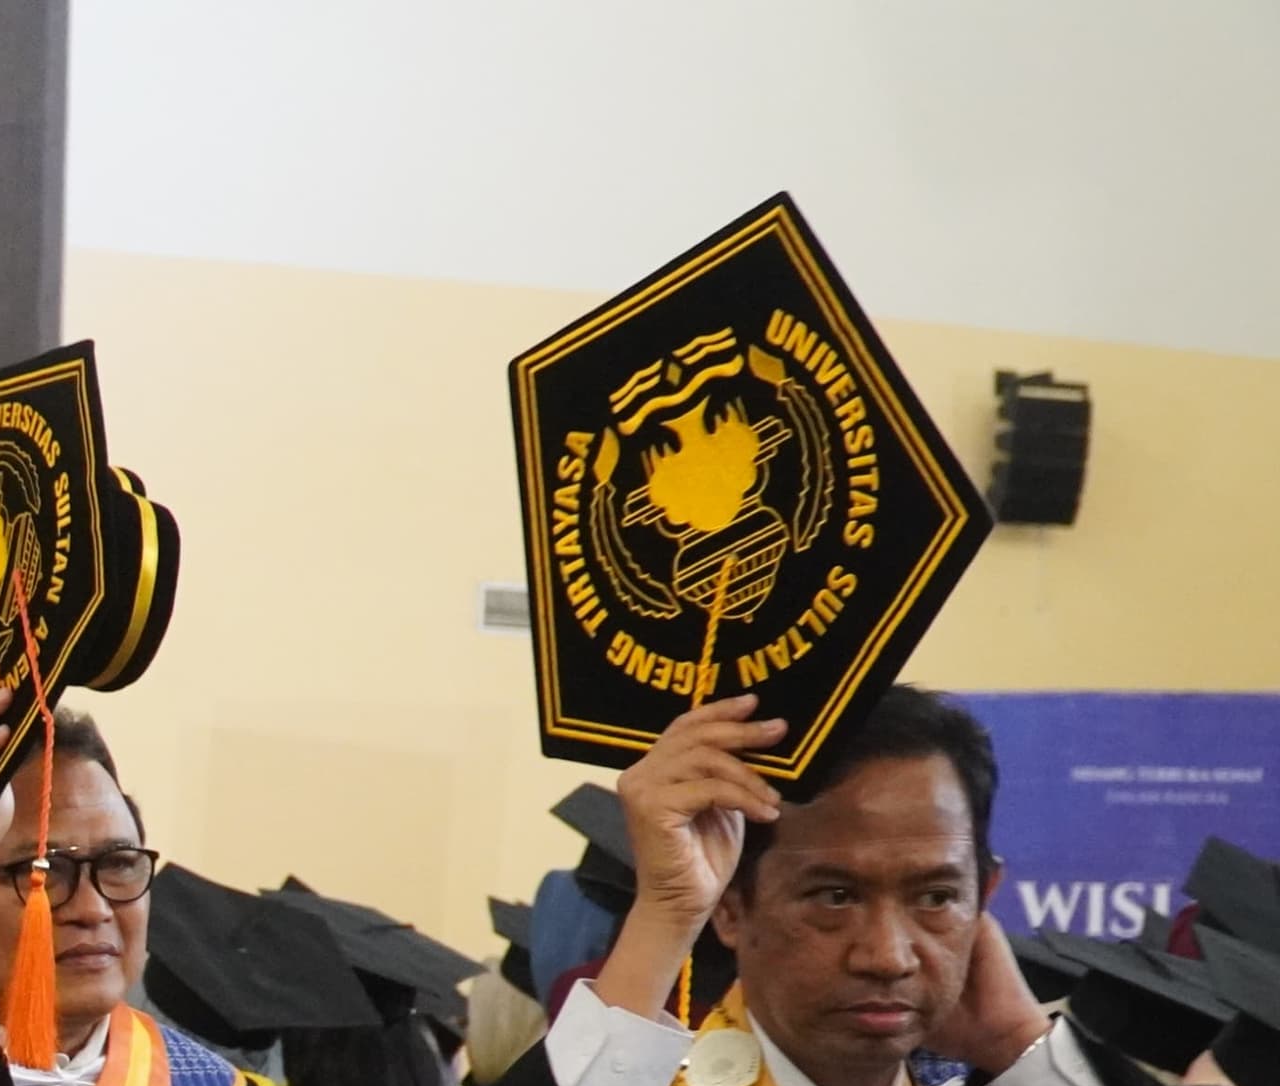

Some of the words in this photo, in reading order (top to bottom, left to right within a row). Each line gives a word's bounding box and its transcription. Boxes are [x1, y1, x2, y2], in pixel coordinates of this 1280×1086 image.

[765, 309, 879, 549] UNIVERSITAS
[46, 471, 72, 604] SULTAN
[552, 429, 610, 639] TIRTAYASA
[737, 565, 858, 688] SULTAN
